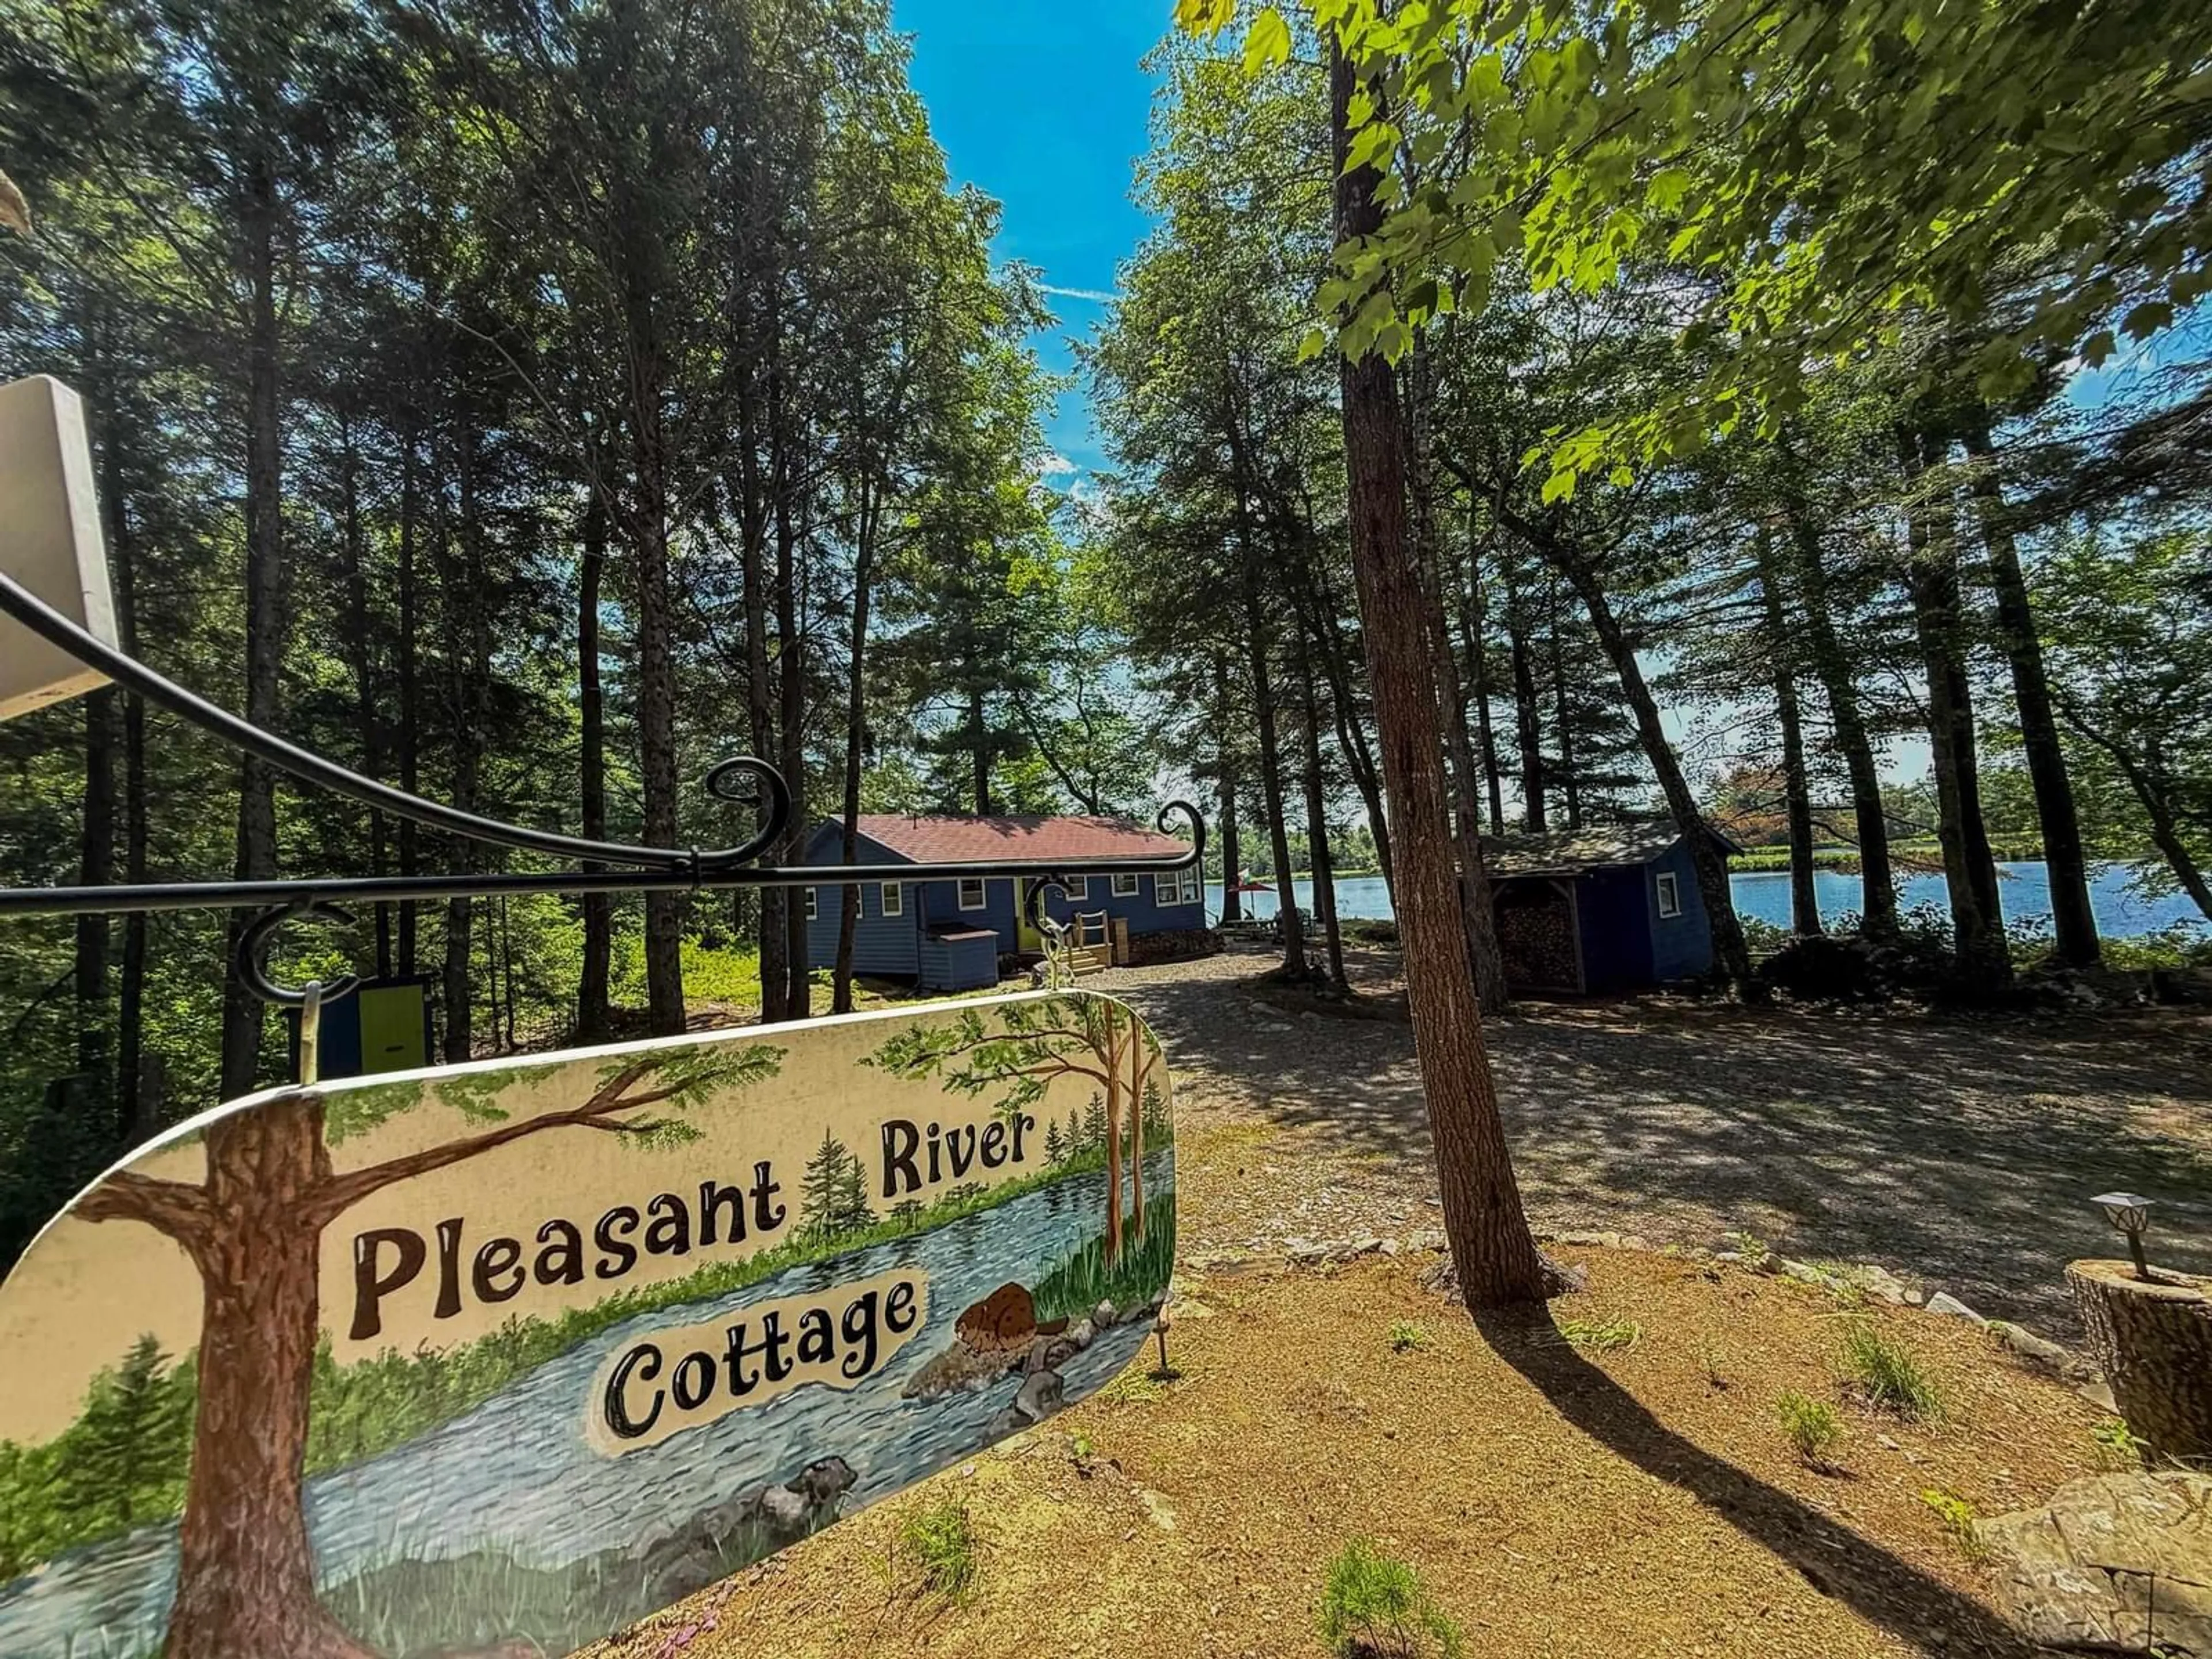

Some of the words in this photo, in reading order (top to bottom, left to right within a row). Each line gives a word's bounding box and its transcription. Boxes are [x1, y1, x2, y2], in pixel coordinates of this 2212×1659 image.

[349, 1160, 786, 1340] Pleasant
[881, 1112, 1035, 1198] River
[604, 1281, 917, 1438] Cottage
